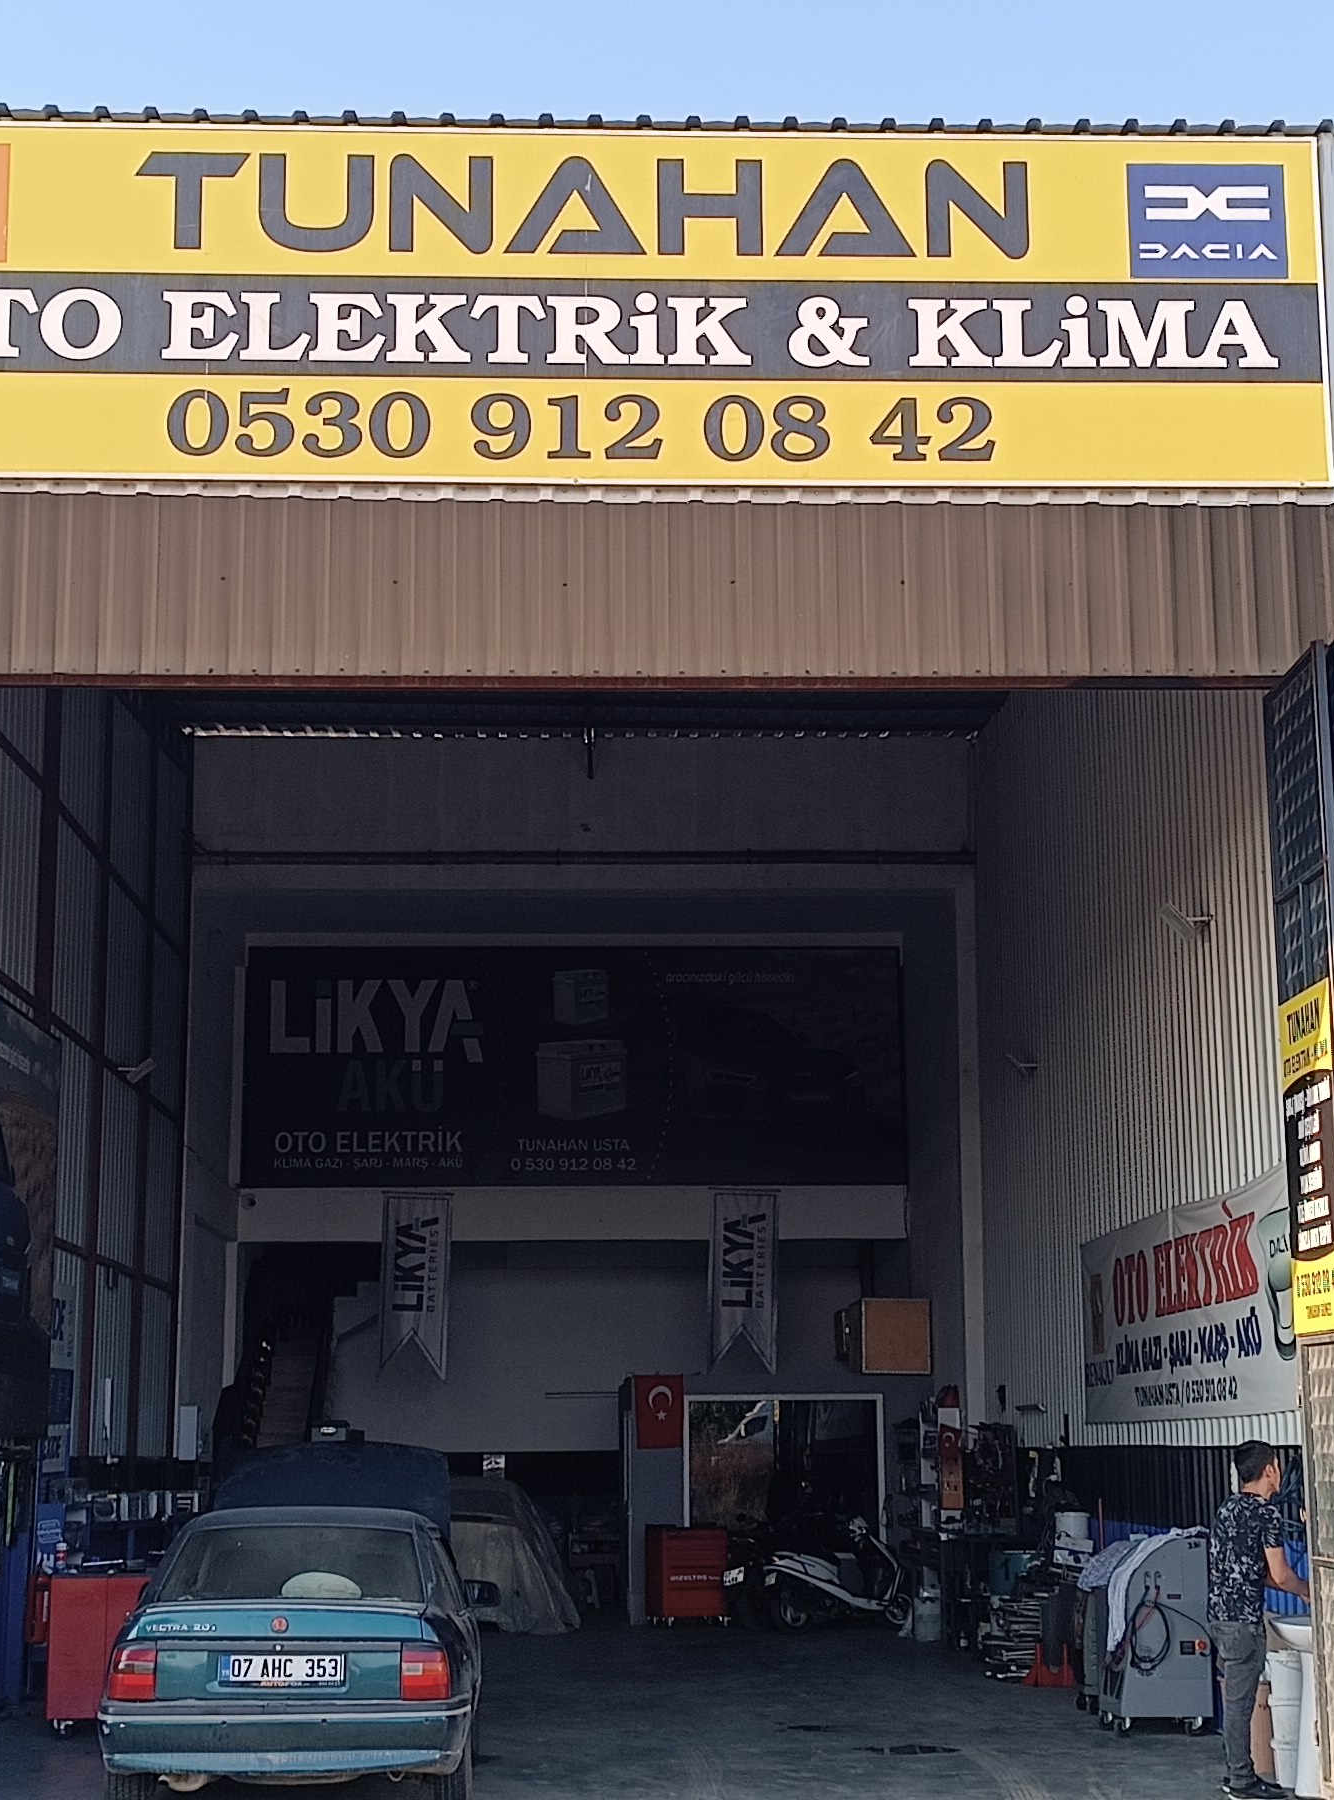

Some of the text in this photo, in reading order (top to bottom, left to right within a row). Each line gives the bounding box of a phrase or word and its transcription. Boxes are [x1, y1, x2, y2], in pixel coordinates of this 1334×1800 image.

[136, 150, 1030, 260] TUNAHAN
[1138, 242, 1278, 261] DACIA
[788, 294, 870, 368] &
[167, 387, 996, 462] 0530 912 08 42
[335, 1058, 445, 1113] AKÜ
[273, 1125, 464, 1154] OTO ELEKTRİK
[510, 1158, 637, 1172] 0 530 912 08 42
[516, 1138, 631, 1153] TUNAHAN USTA
[426, 1226, 440, 1313] BATTERIES
[755, 1225, 766, 1309] BATTERIES
[1113, 1249, 1149, 1327] OTO
[231, 1658, 339, 1678] 07 AHC 353
